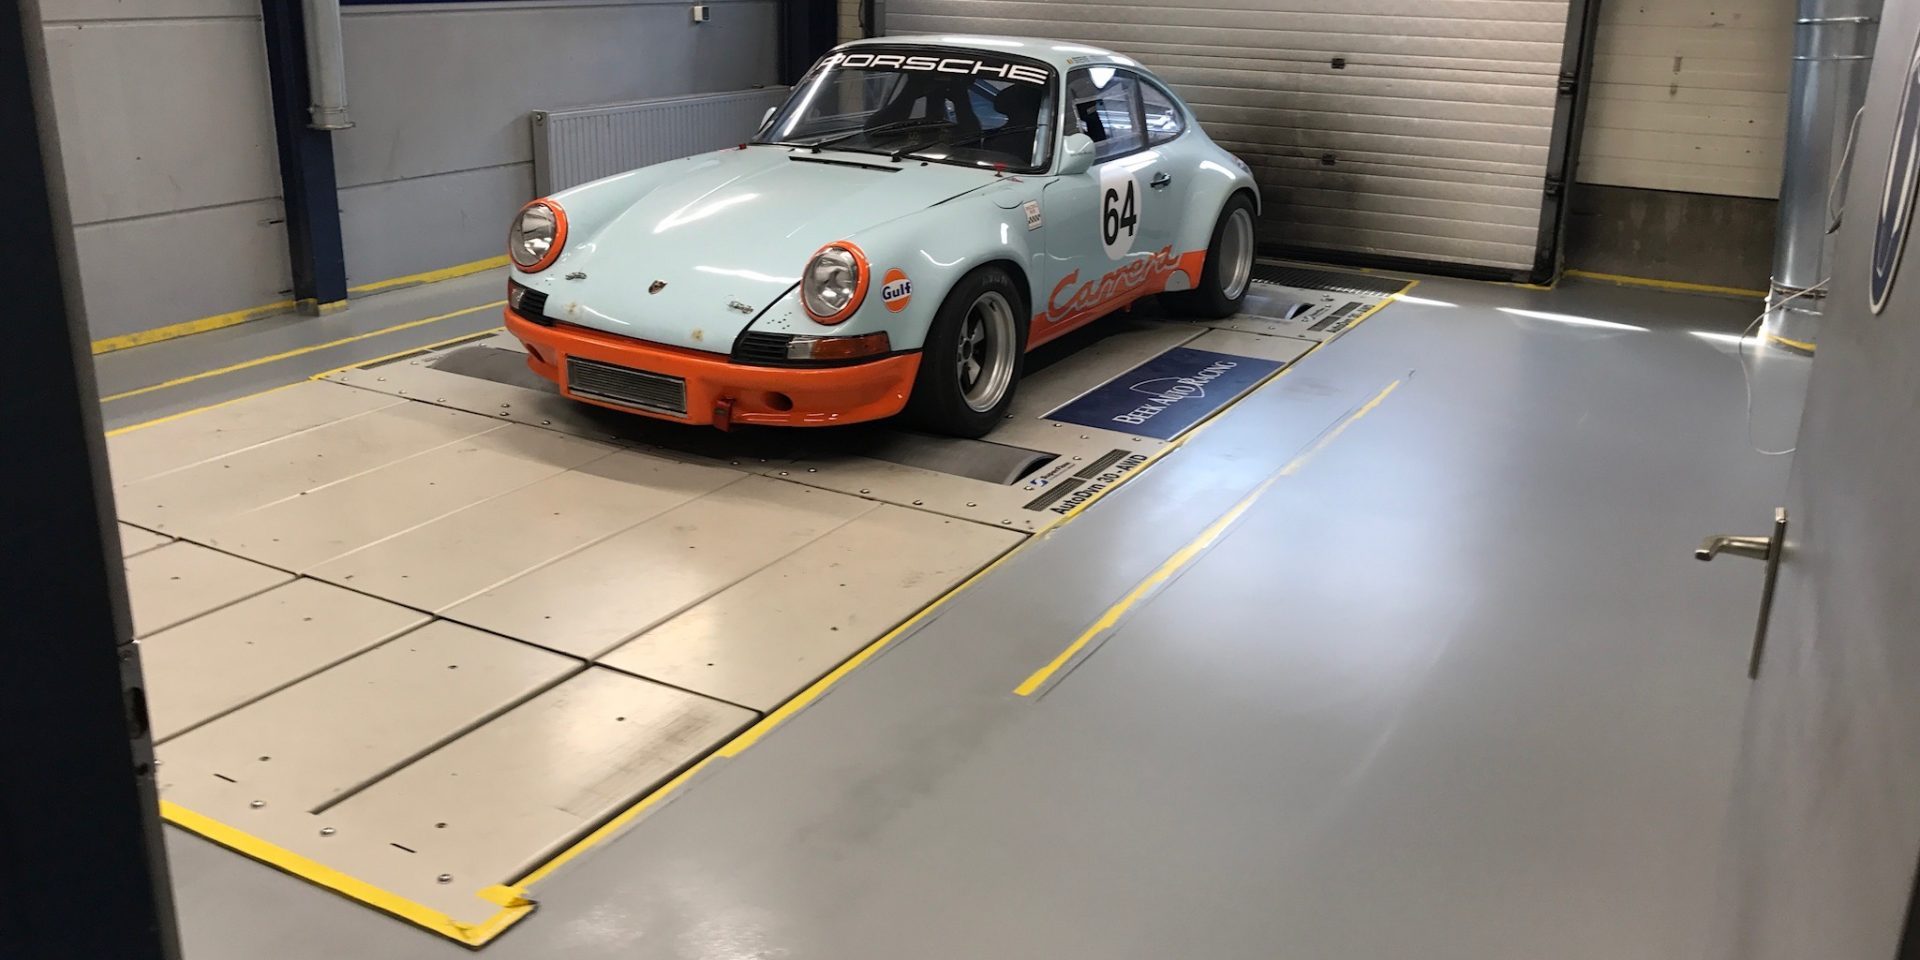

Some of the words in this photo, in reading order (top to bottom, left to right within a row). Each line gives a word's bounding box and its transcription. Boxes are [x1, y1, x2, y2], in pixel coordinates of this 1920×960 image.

[816, 53, 1049, 85] PORSCHE
[1103, 180, 1137, 246] 64
[882, 281, 911, 301] Gulf
[1047, 245, 1181, 322] Carrera
[1177, 360, 1238, 387] RACING
